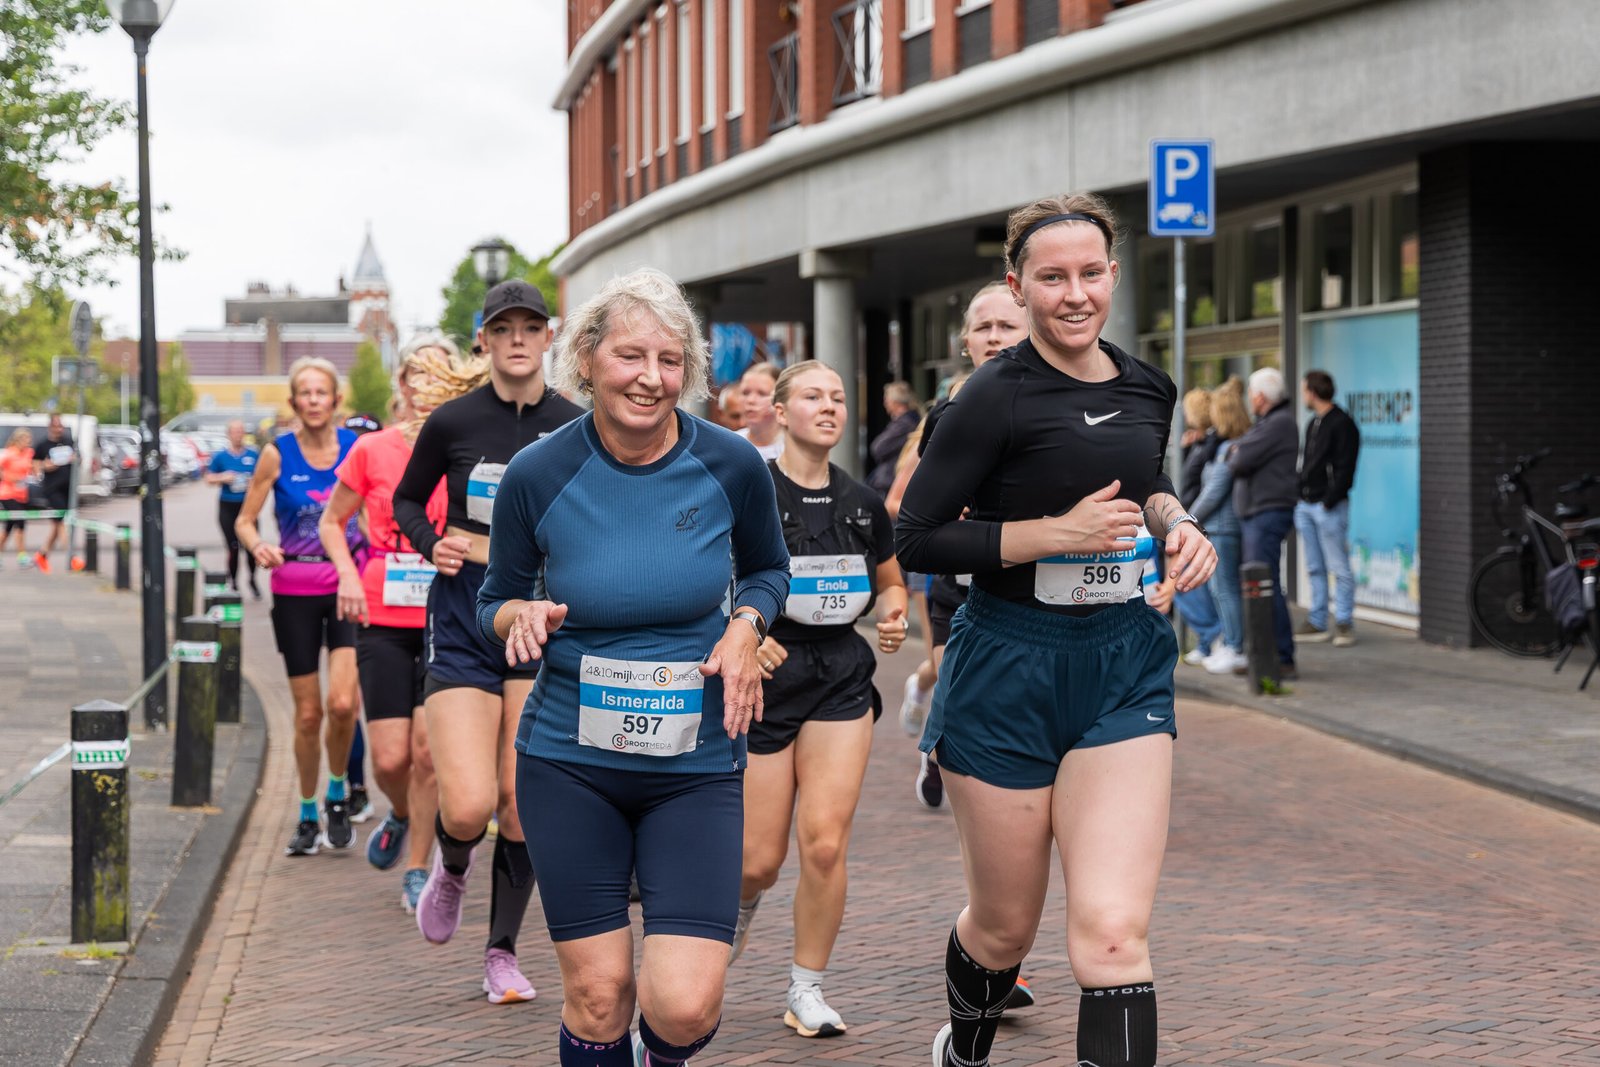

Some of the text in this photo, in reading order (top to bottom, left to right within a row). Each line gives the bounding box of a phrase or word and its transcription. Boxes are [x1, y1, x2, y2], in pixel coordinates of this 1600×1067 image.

[1165, 148, 1200, 197] P
[1083, 565, 1121, 585] 596
[816, 579, 849, 592] Enola
[819, 595, 847, 610] 735
[673, 670, 700, 682] sneek
[601, 690, 685, 710] Ismeralda
[622, 714, 663, 735] 597
[624, 739, 672, 750] GROOTMEDIA
[1093, 986, 1150, 997] STOX
